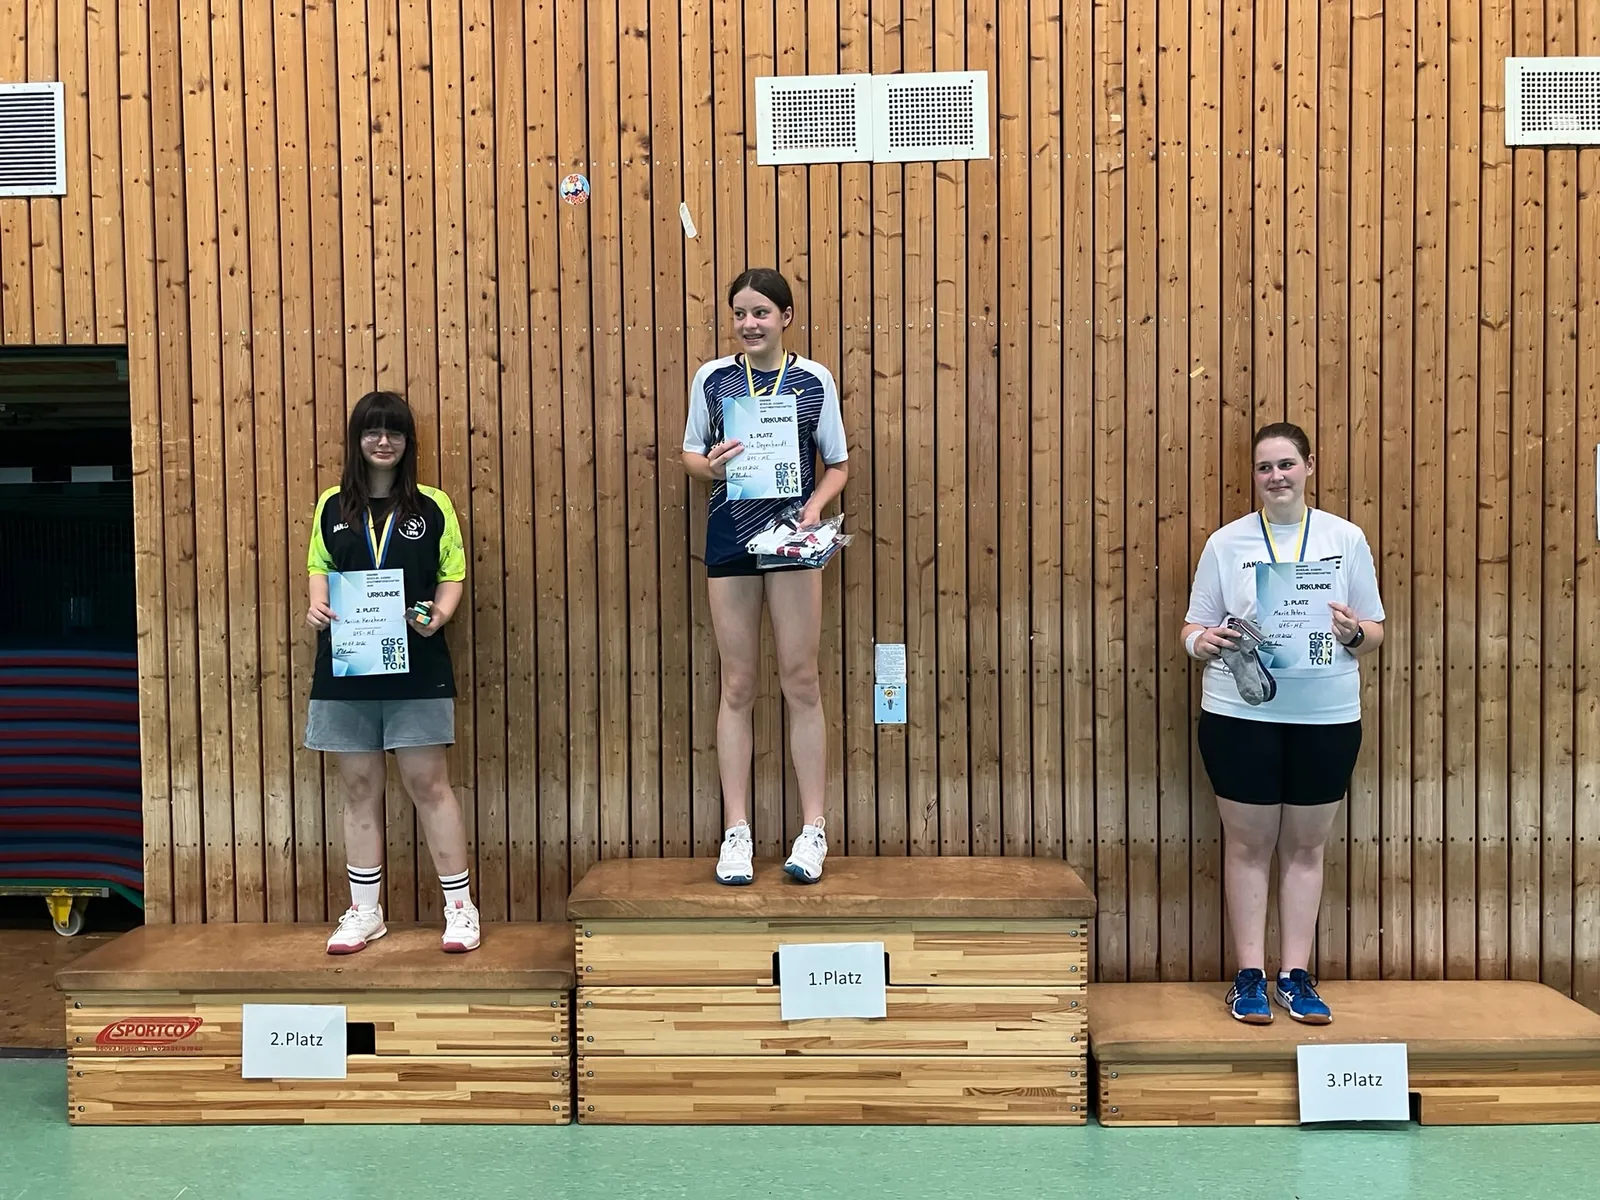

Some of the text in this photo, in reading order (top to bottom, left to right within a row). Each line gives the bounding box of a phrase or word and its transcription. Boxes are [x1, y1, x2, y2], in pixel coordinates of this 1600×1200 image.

[760, 416, 793, 424] URKUNDE
[775, 470, 798, 479] BAD
[776, 478, 798, 487] MIN
[776, 486, 799, 494] TON
[367, 590, 400, 598] URKUNDE
[1309, 640, 1333, 649] BAD
[382, 646, 405, 654] BAD
[1309, 648, 1333, 657] MIN
[382, 654, 406, 662] MIN
[1309, 656, 1332, 665] TON
[383, 662, 406, 670] TON
[808, 970, 862, 986] 1.Platz
[112, 1023, 185, 1038] SPORTCO
[270, 1031, 323, 1047] 2.Platz
[1326, 1072, 1383, 1088] 3.Platz
